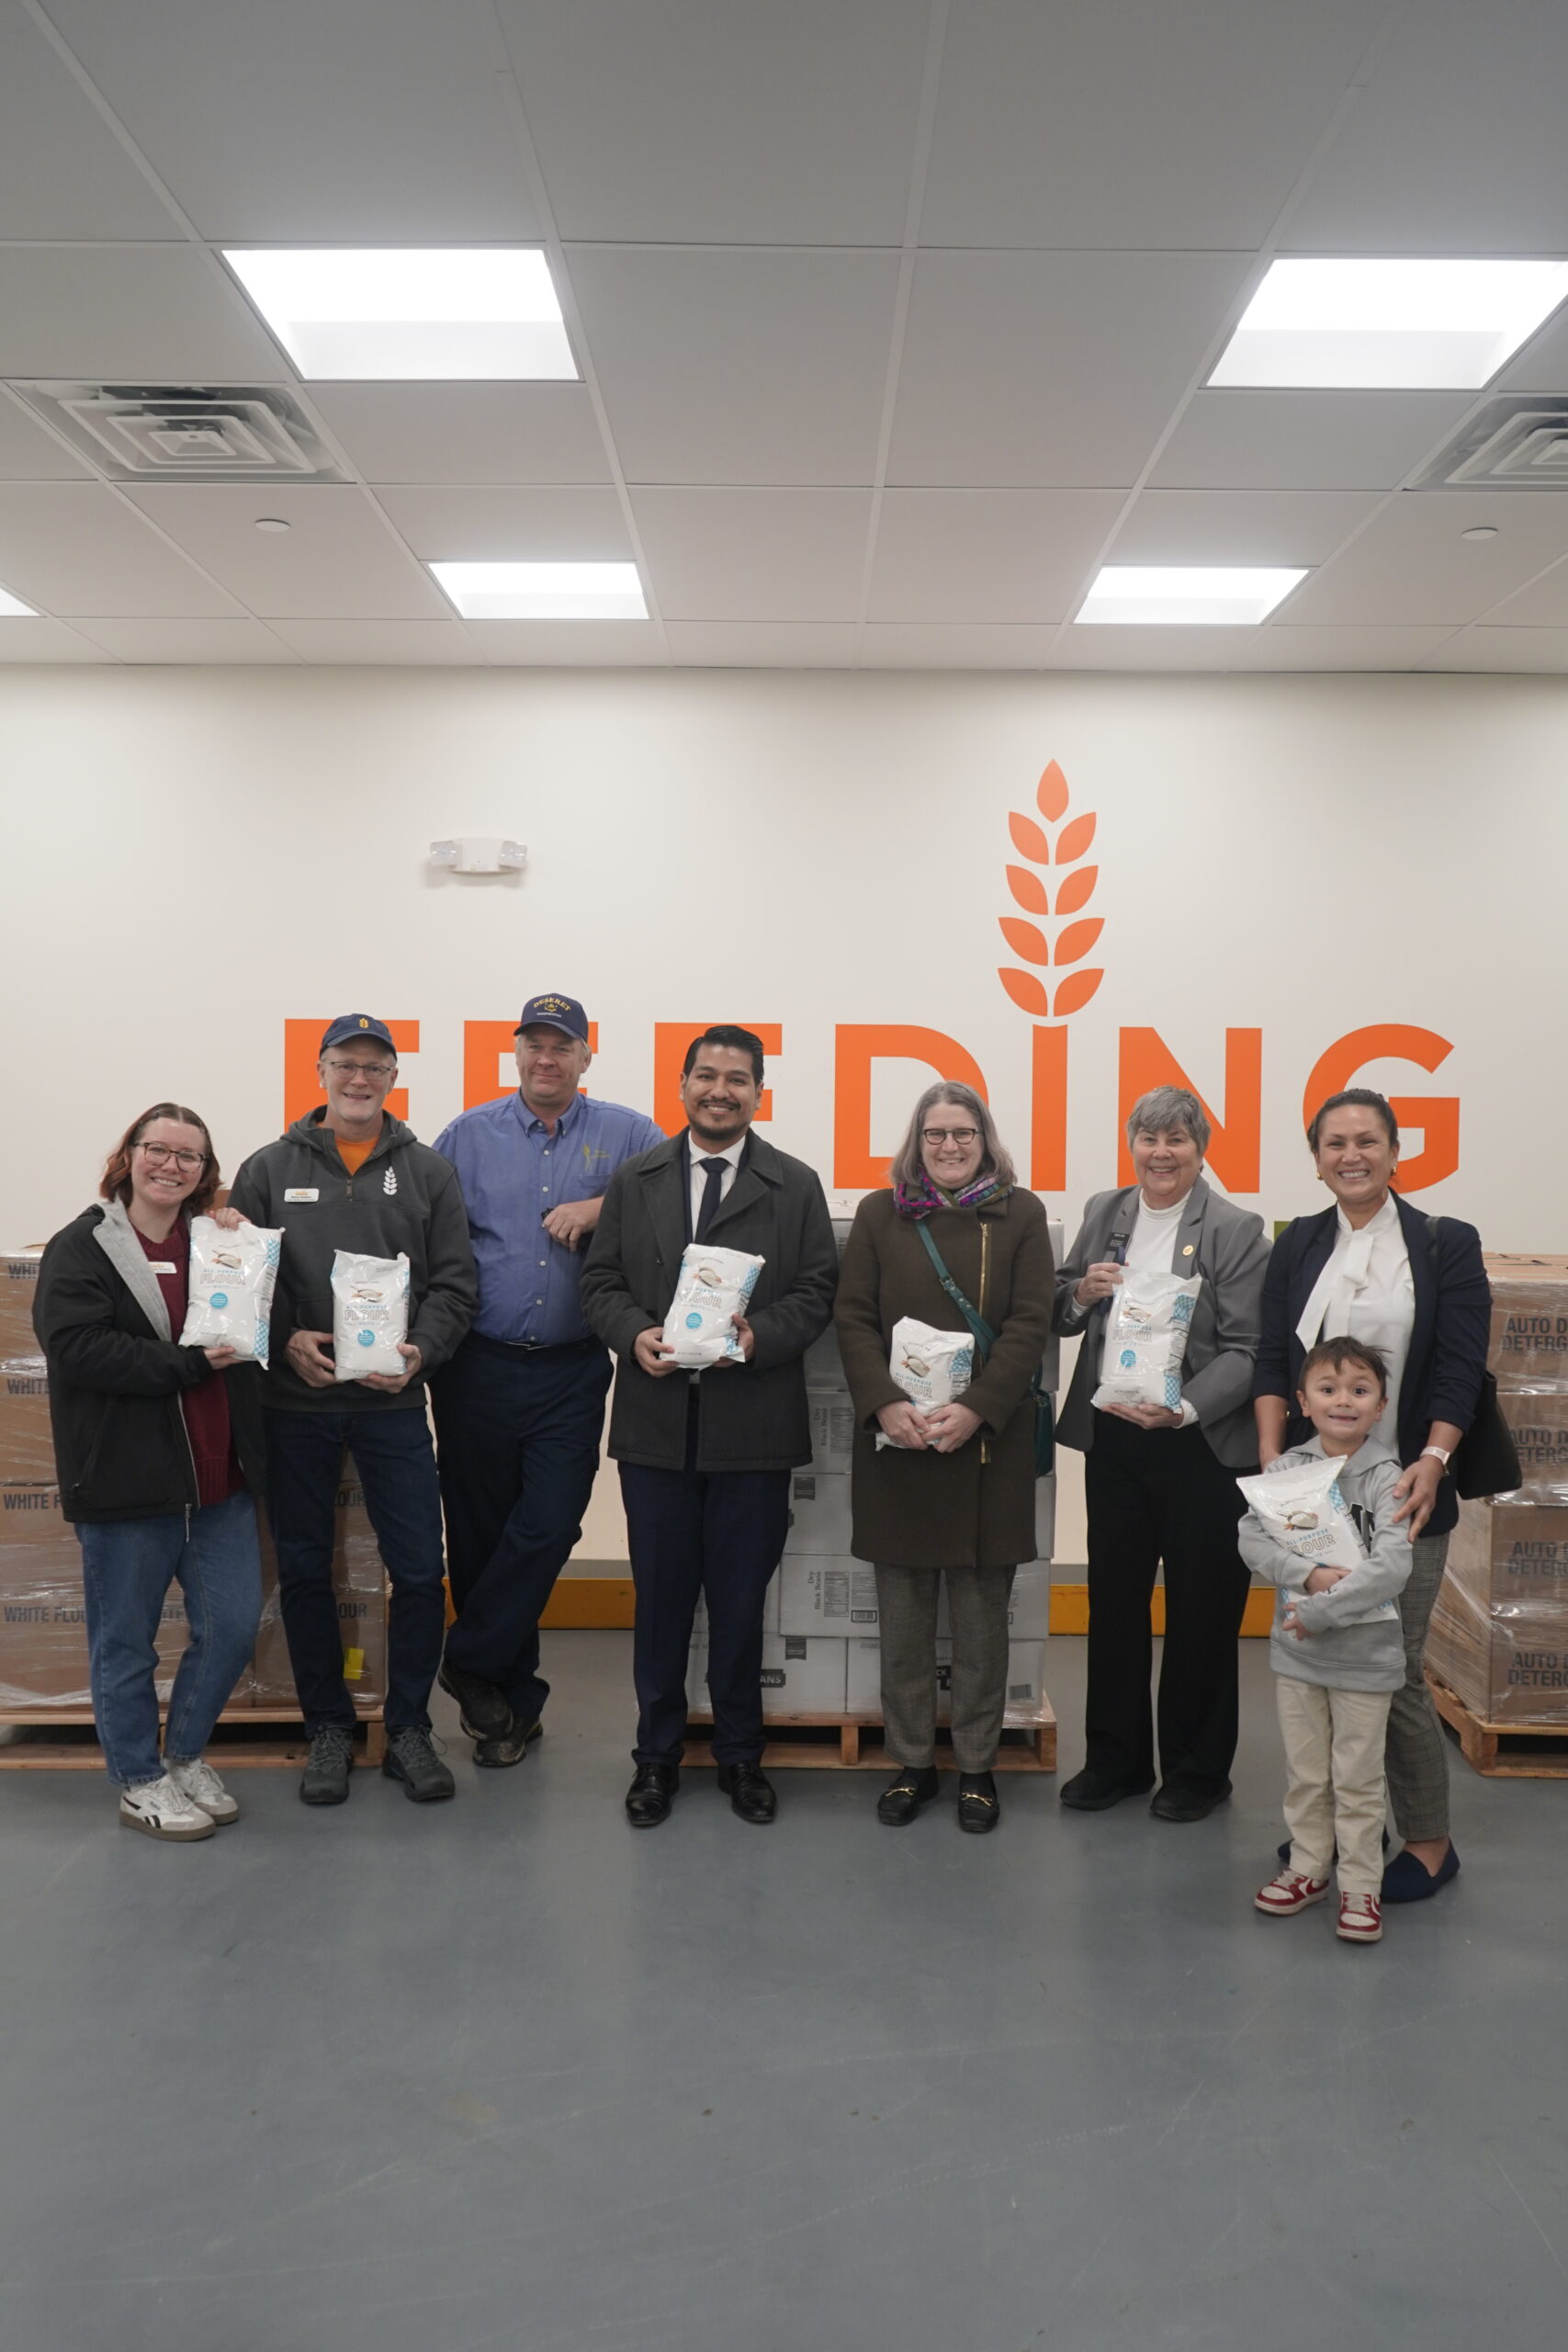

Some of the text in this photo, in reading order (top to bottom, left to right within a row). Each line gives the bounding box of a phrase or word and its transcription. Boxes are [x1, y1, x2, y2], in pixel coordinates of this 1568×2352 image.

[533, 997, 572, 1011] DESERET
[8, 1263, 40, 1279] WHI
[199, 1272, 246, 1285] FLOUR
[344, 1310, 389, 1321] FLOUR
[1506, 1317, 1551, 1333] AUTO
[4, 1494, 49, 1510] WHITE
[1286, 1528, 1329, 1545] ALL-PURPOSE
[1512, 1542, 1557, 1558] AUTO
[807, 1571, 817, 1584] Dry
[813, 1571, 821, 1610] Black Beans
[5, 1606, 51, 1623] WHITE
[338, 1602, 367, 1619] OUR
[1512, 1652, 1557, 1669] AUTO
[759, 1675, 781, 1684] ANS
